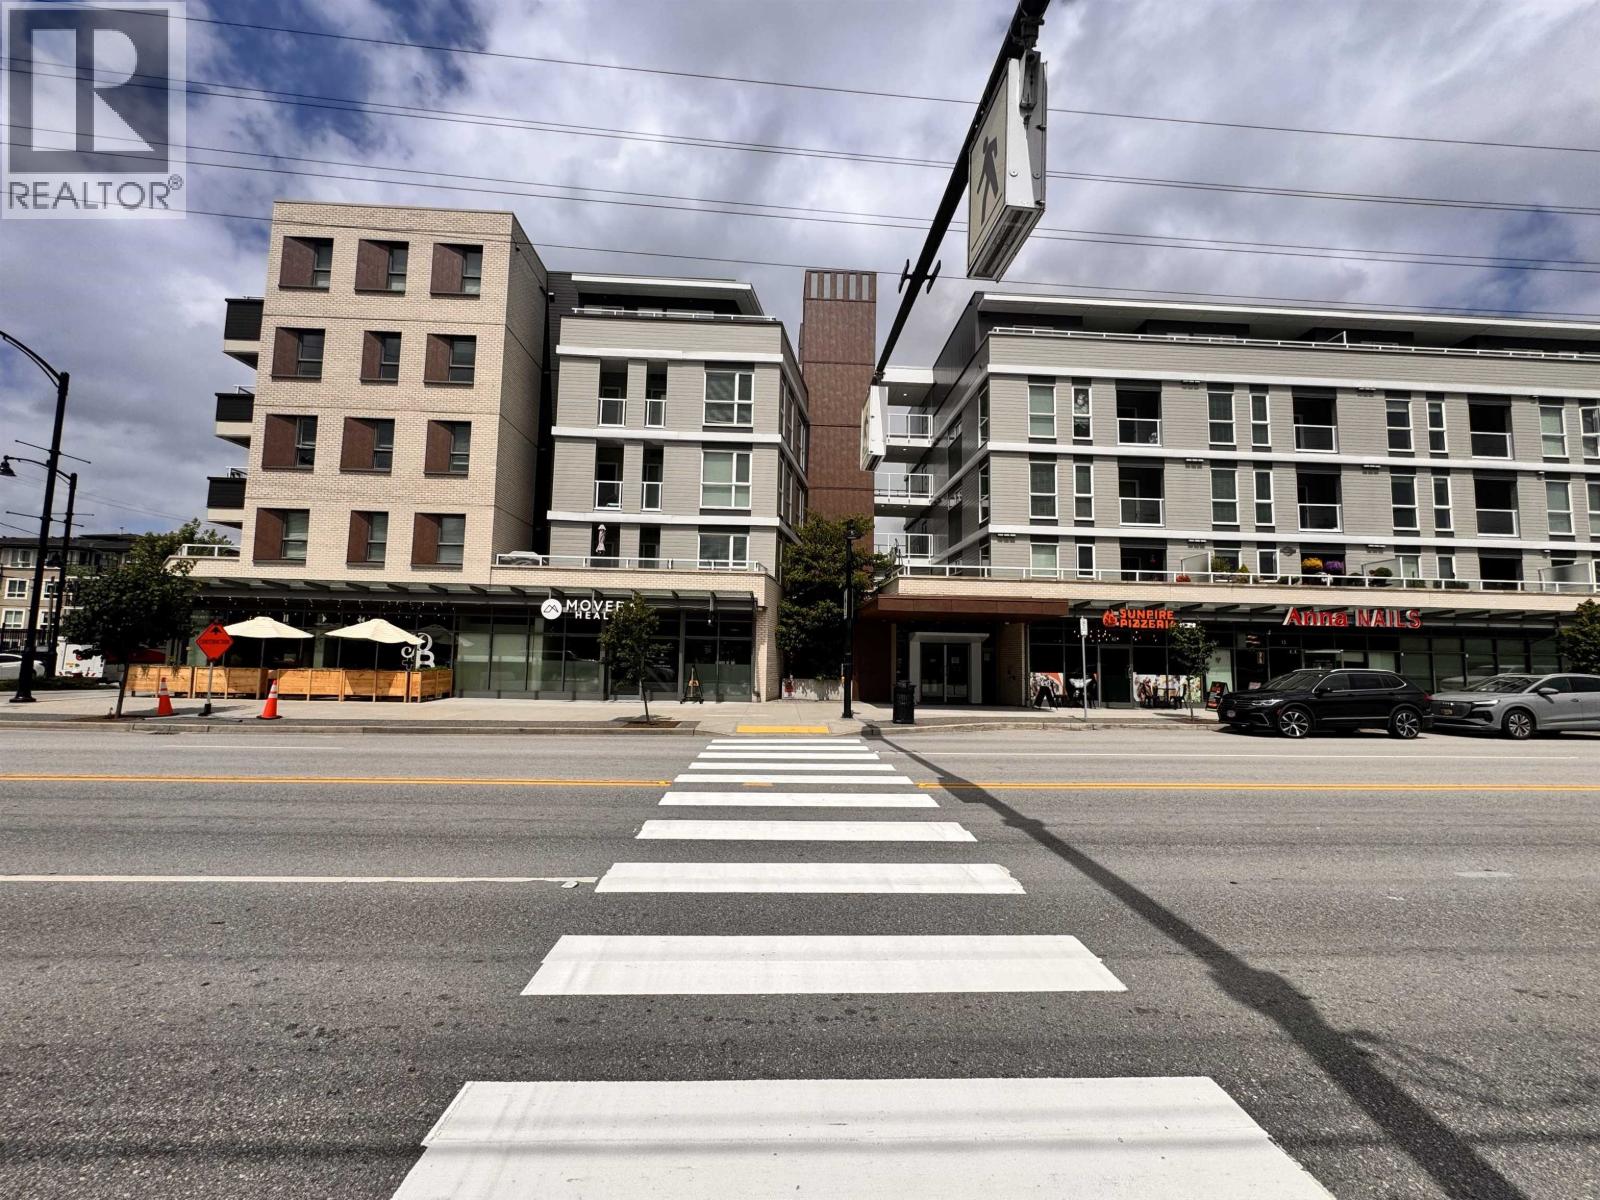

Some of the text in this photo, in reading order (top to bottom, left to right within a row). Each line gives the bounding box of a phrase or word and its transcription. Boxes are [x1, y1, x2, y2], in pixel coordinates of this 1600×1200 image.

[1120, 608, 1175, 620] SUNFIRE
[1282, 606, 1422, 629] Anna NAILS
